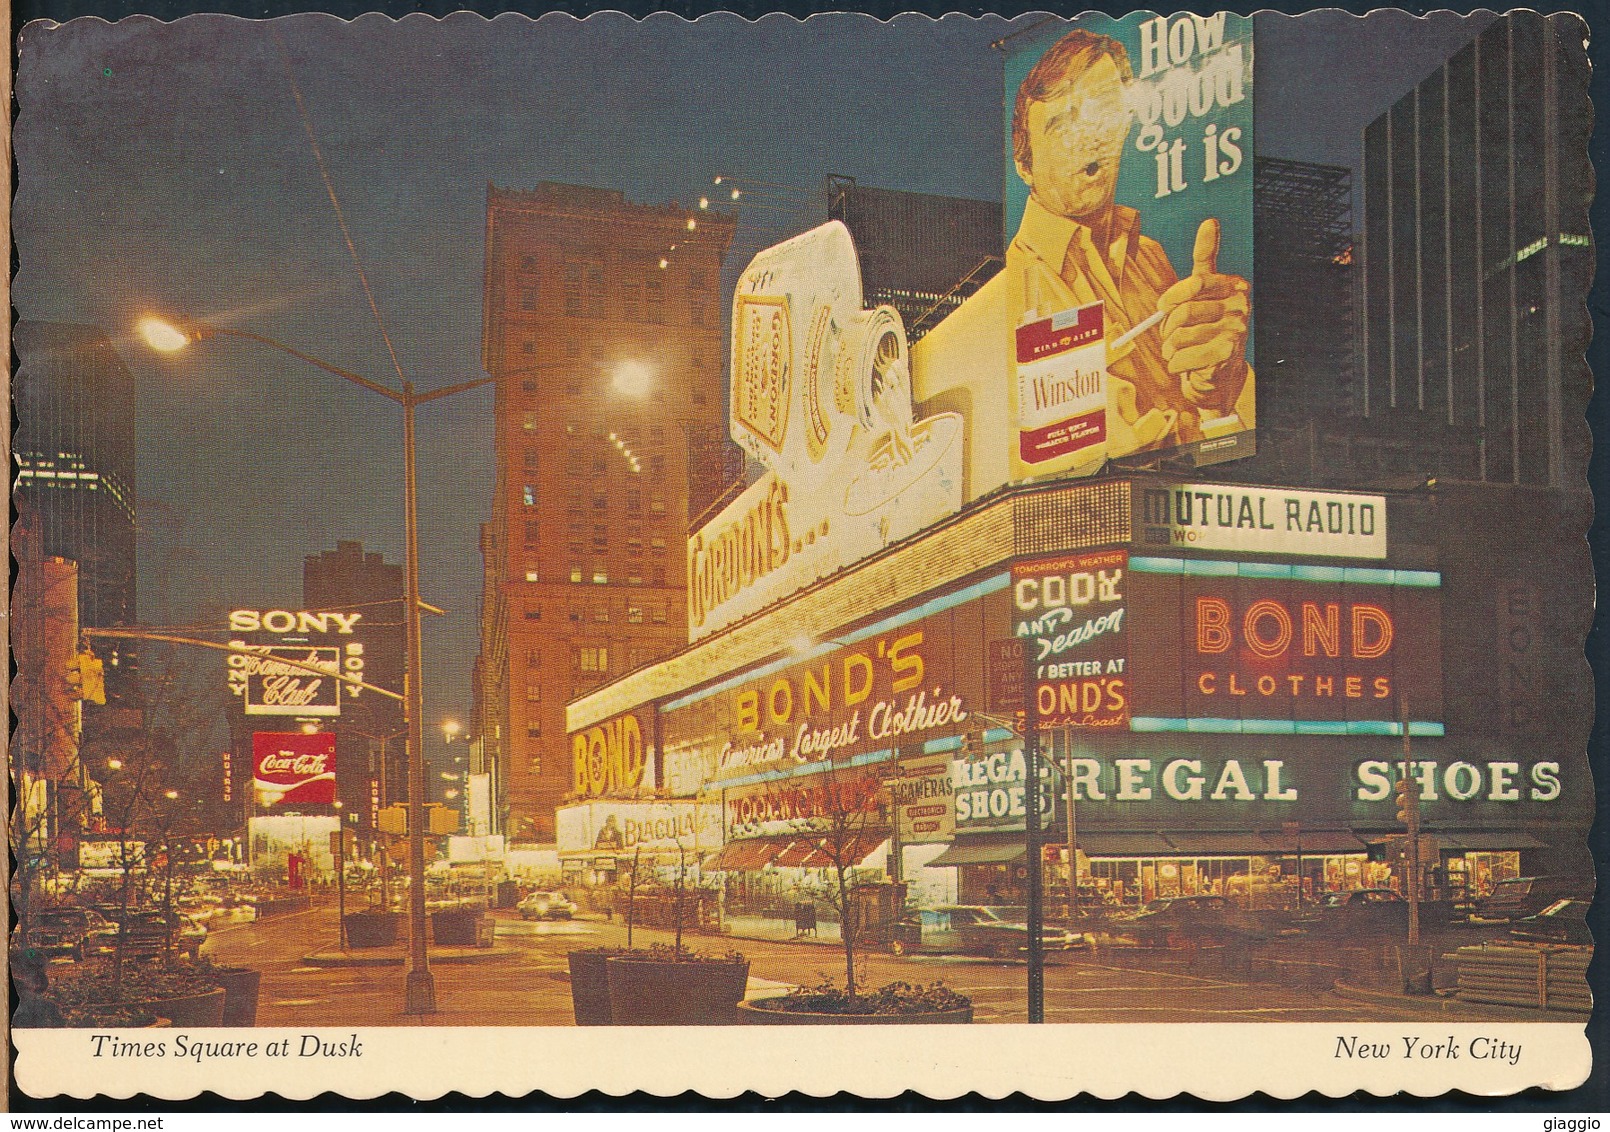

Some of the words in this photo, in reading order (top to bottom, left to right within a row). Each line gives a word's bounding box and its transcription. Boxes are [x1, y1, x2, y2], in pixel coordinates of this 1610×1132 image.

[1139, 11, 1226, 78] How
[1155, 138, 1188, 199] it
[1203, 123, 1242, 182] is
[1033, 369, 1100, 411] Winston
[1285, 497, 1375, 537] RADIO
[1013, 559, 1075, 574] TOMORROW'S
[1079, 554, 1123, 568] WEATHER
[229, 609, 362, 634] SONY
[1197, 597, 1394, 659] BOND
[228, 640, 247, 697] SONY
[345, 642, 364, 698] SONY
[737, 632, 924, 733] BOND'S
[1047, 660, 1101, 679] BETTER
[1106, 658, 1125, 674] AT
[1198, 671, 1390, 699] CLOTHES
[262, 675, 322, 705] Club
[1037, 678, 1125, 716] OND'S
[790, 709, 861, 763] Largest
[868, 687, 968, 740] Clothier
[259, 753, 329, 775] Coca-Cola
[573, 713, 642, 796] BOND
[953, 749, 1049, 788] REGA
[901, 777, 953, 799] CAMERAS
[1060, 758, 1298, 802] REGAL
[1357, 760, 1562, 802] SHOES
[624, 812, 696, 847] BLACULA
[90, 1035, 166, 1058] Times
[174, 1035, 258, 1063] Square
[265, 1039, 290, 1058] at
[298, 1034, 363, 1058] Dusk
[1334, 1036, 1391, 1059] New
[1401, 1036, 1460, 1060] York
[1469, 1037, 1522, 1066] City
